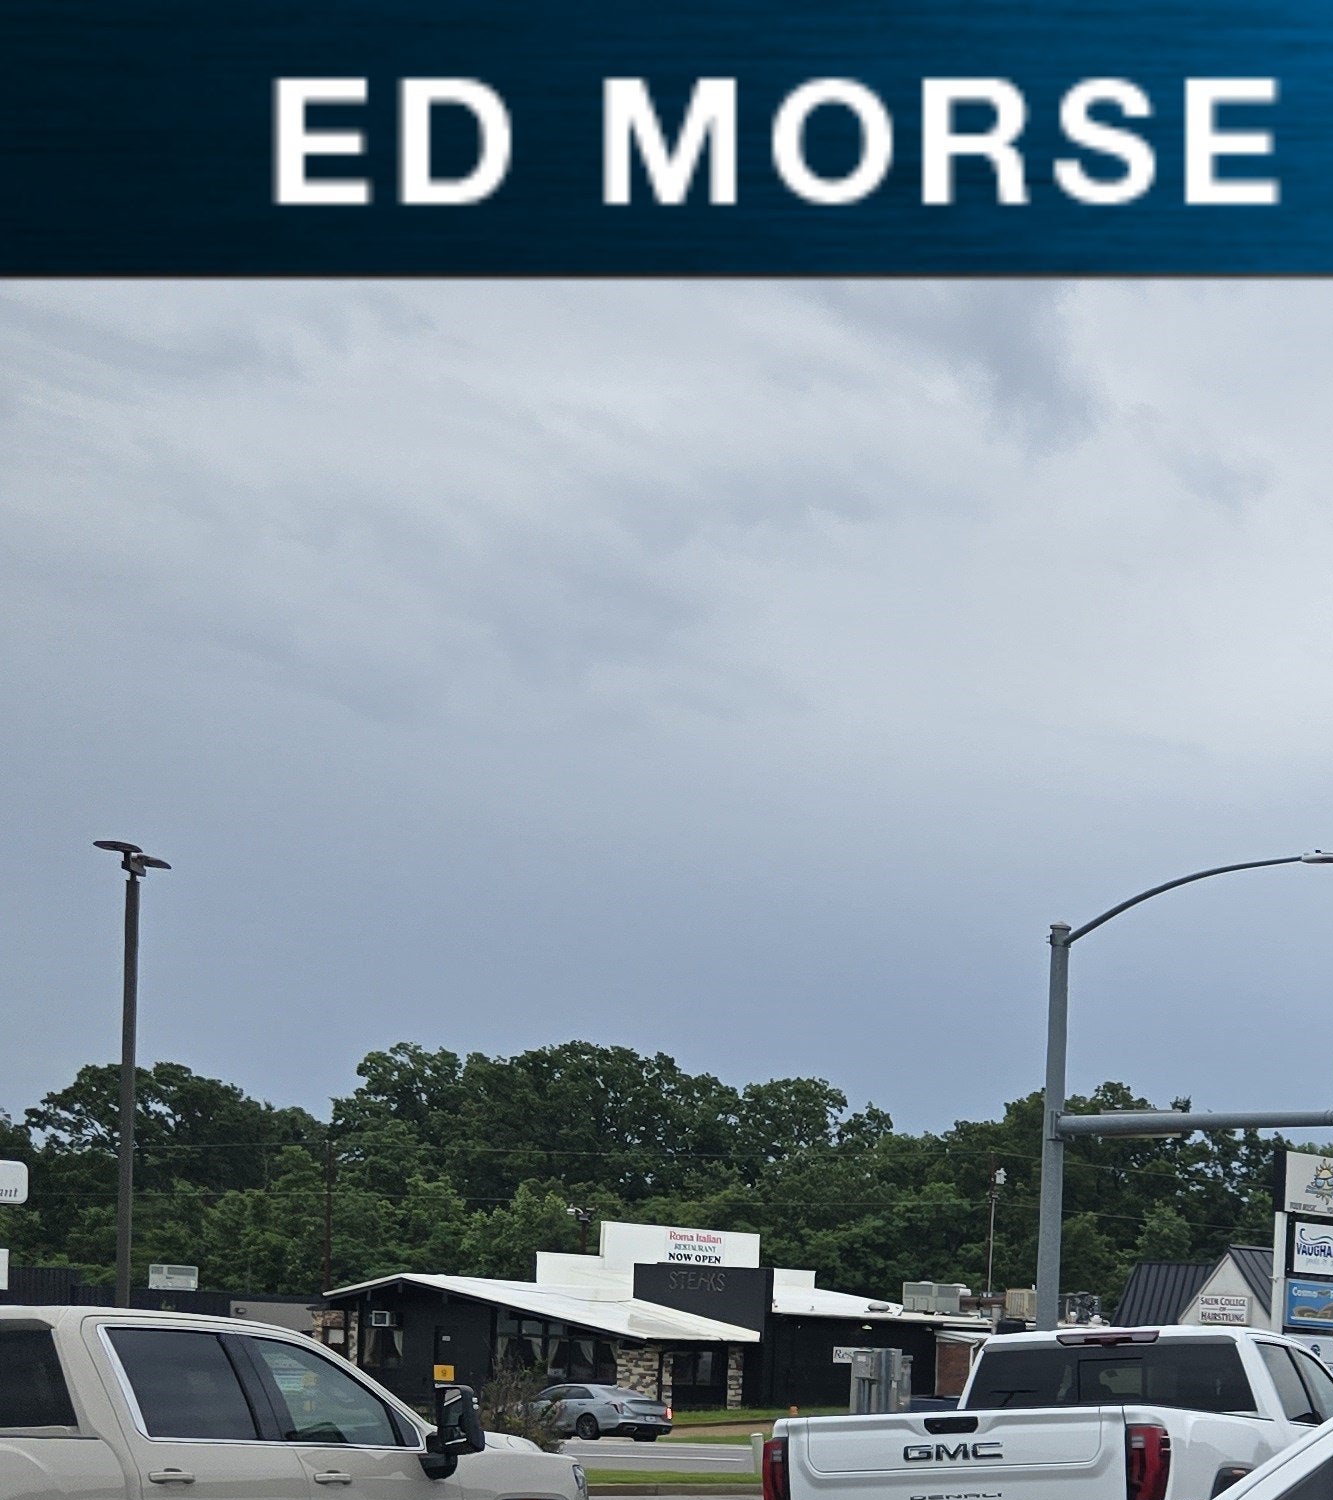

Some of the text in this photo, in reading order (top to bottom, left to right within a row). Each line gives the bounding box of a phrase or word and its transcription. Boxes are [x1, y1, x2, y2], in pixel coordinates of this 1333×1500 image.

[669, 1230, 722, 1244] Roma Italian
[674, 1243, 717, 1254] RESTAURANT
[668, 1252, 722, 1265] NOW OPEN
[1201, 1311, 1246, 1323] HAIRSTYLING
[903, 1442, 1004, 1463] GMC
